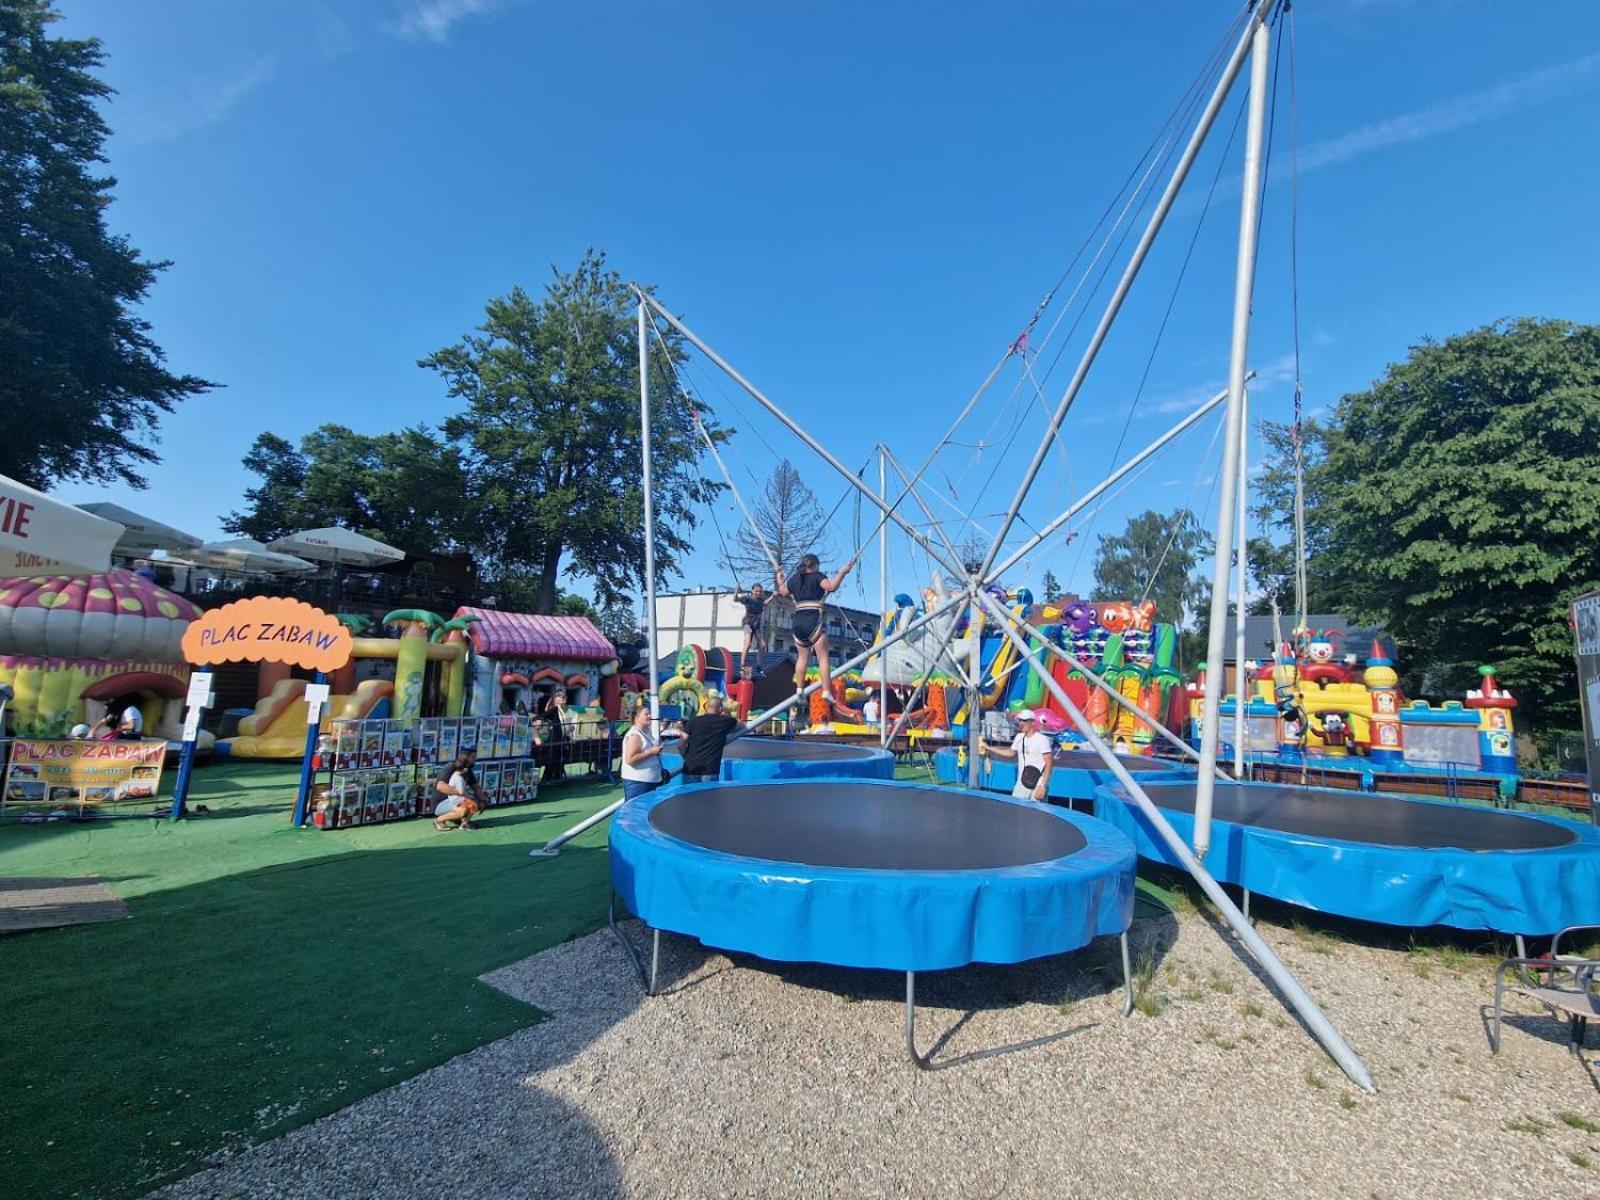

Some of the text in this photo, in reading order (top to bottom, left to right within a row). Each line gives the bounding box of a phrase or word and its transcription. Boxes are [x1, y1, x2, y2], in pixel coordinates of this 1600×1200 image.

[201, 623, 338, 650] PLAC ZABAW
[12, 742, 164, 763] PLAC ZABAW
